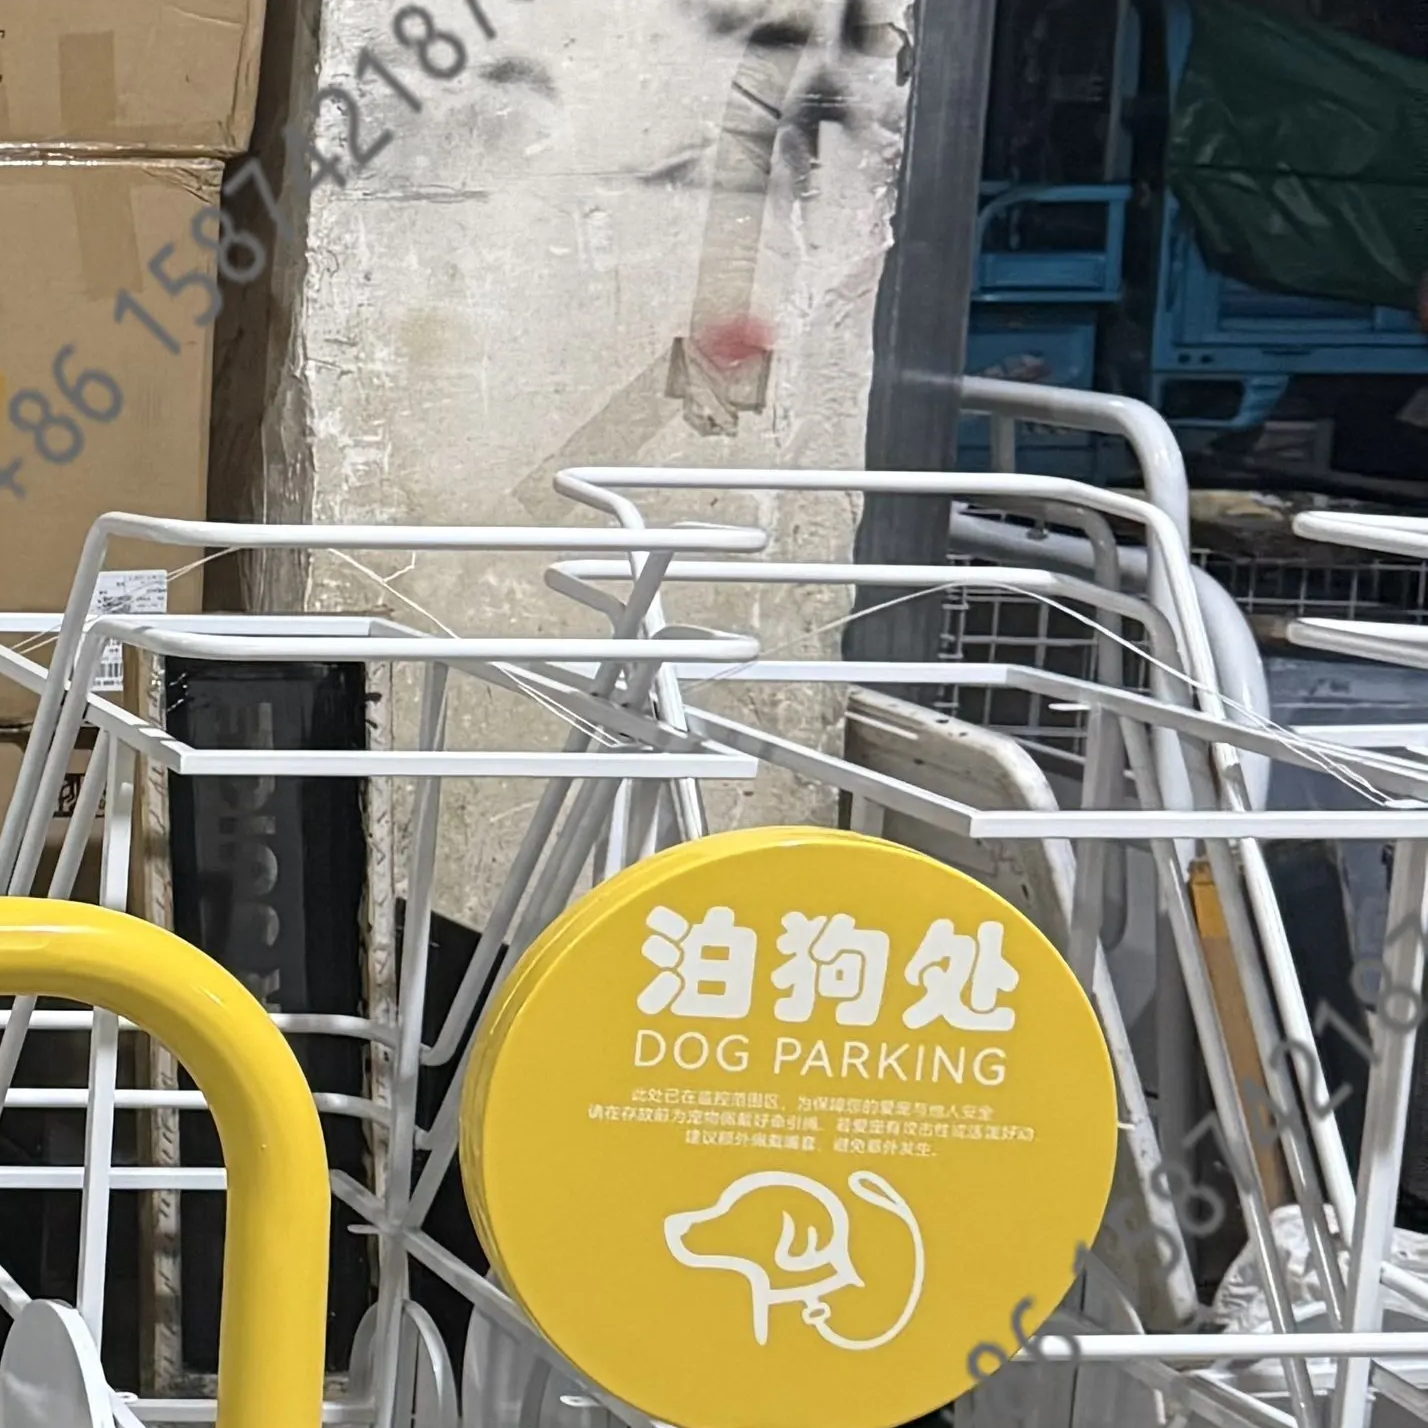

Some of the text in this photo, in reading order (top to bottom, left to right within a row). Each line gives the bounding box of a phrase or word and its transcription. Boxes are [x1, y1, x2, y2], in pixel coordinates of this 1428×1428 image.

[637, 905, 1021, 1033] 泊狗处
[633, 1029, 1007, 1087] DOG PARKING
